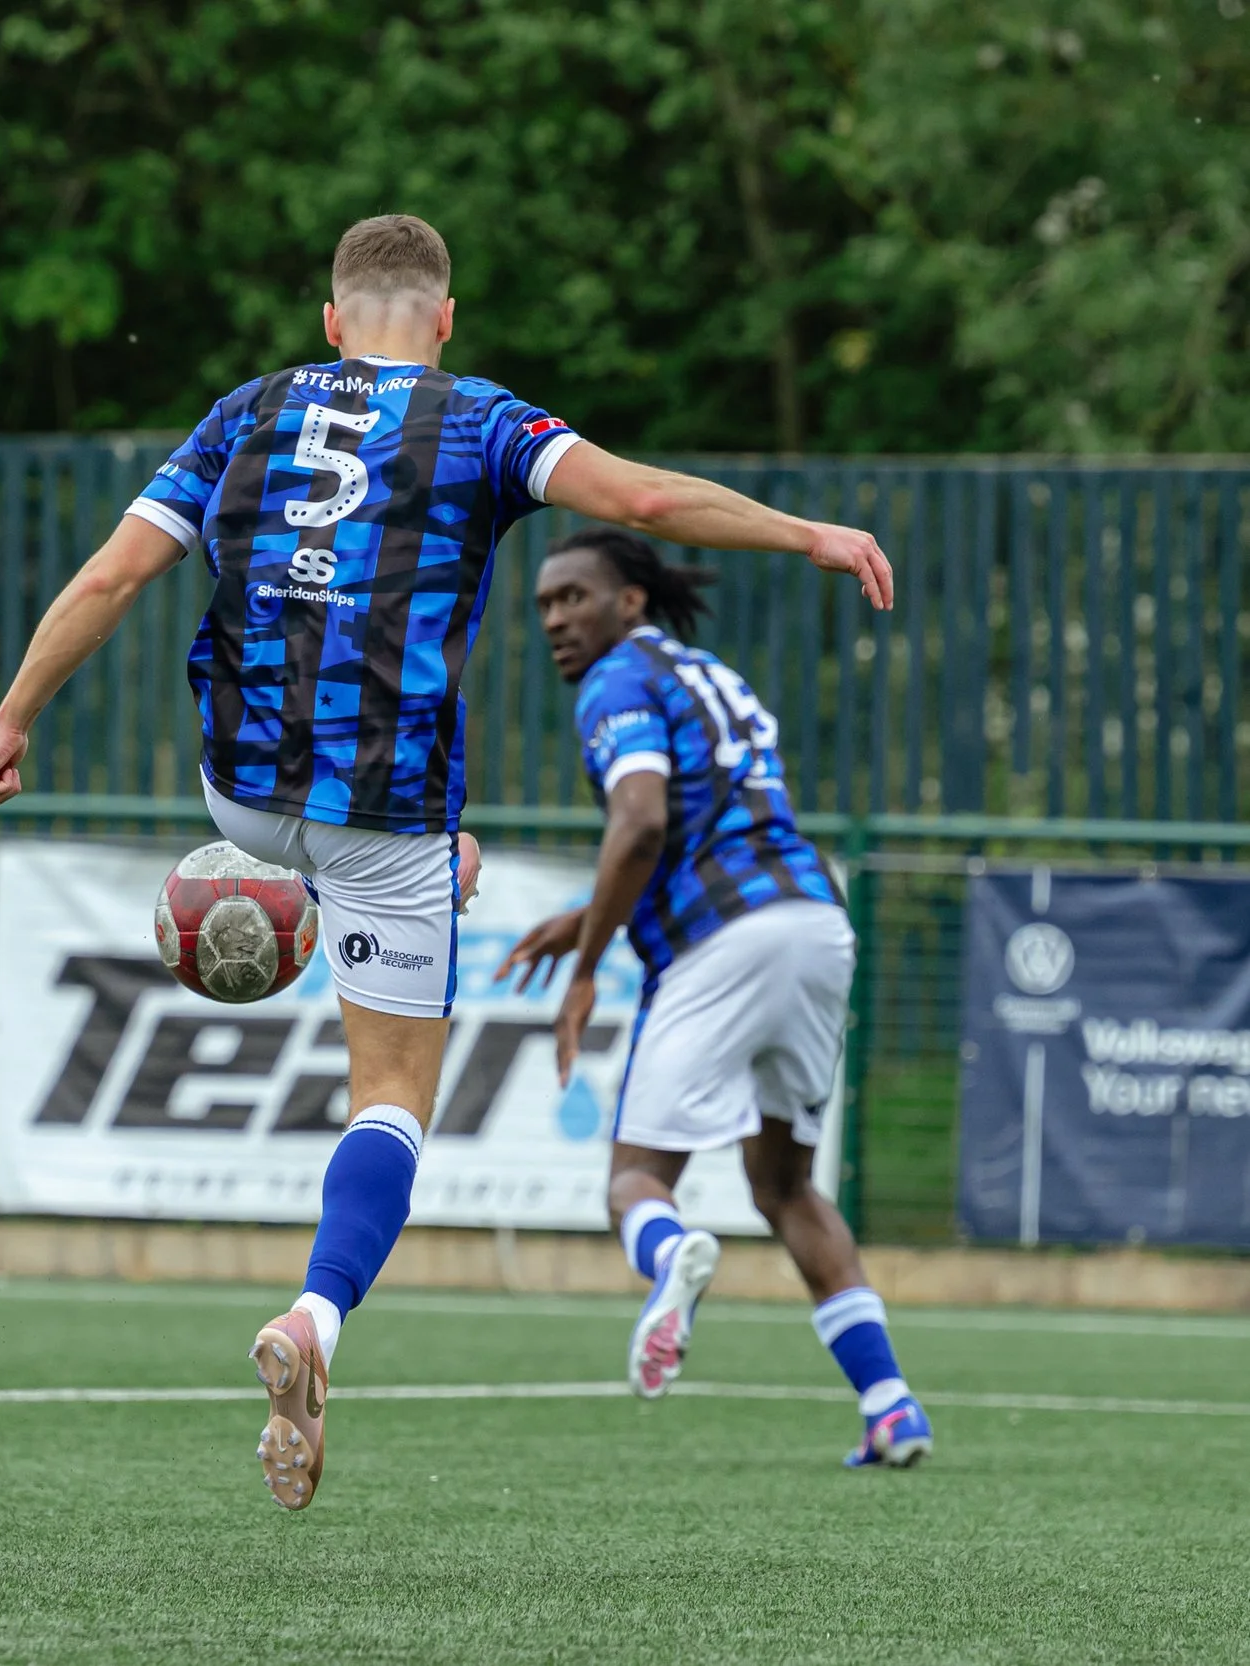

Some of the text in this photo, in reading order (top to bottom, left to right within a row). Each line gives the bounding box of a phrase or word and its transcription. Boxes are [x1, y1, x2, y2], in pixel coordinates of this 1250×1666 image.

[292, 369, 418, 396] #TEAMAVRO
[284, 402, 380, 528] 5
[257, 585, 355, 607] SheridanSkips
[673, 661, 779, 768] 15
[380, 958, 422, 972] SECURITY
[381, 948, 434, 963] ASSOCIATED
[1081, 1061, 1184, 1116] Your
